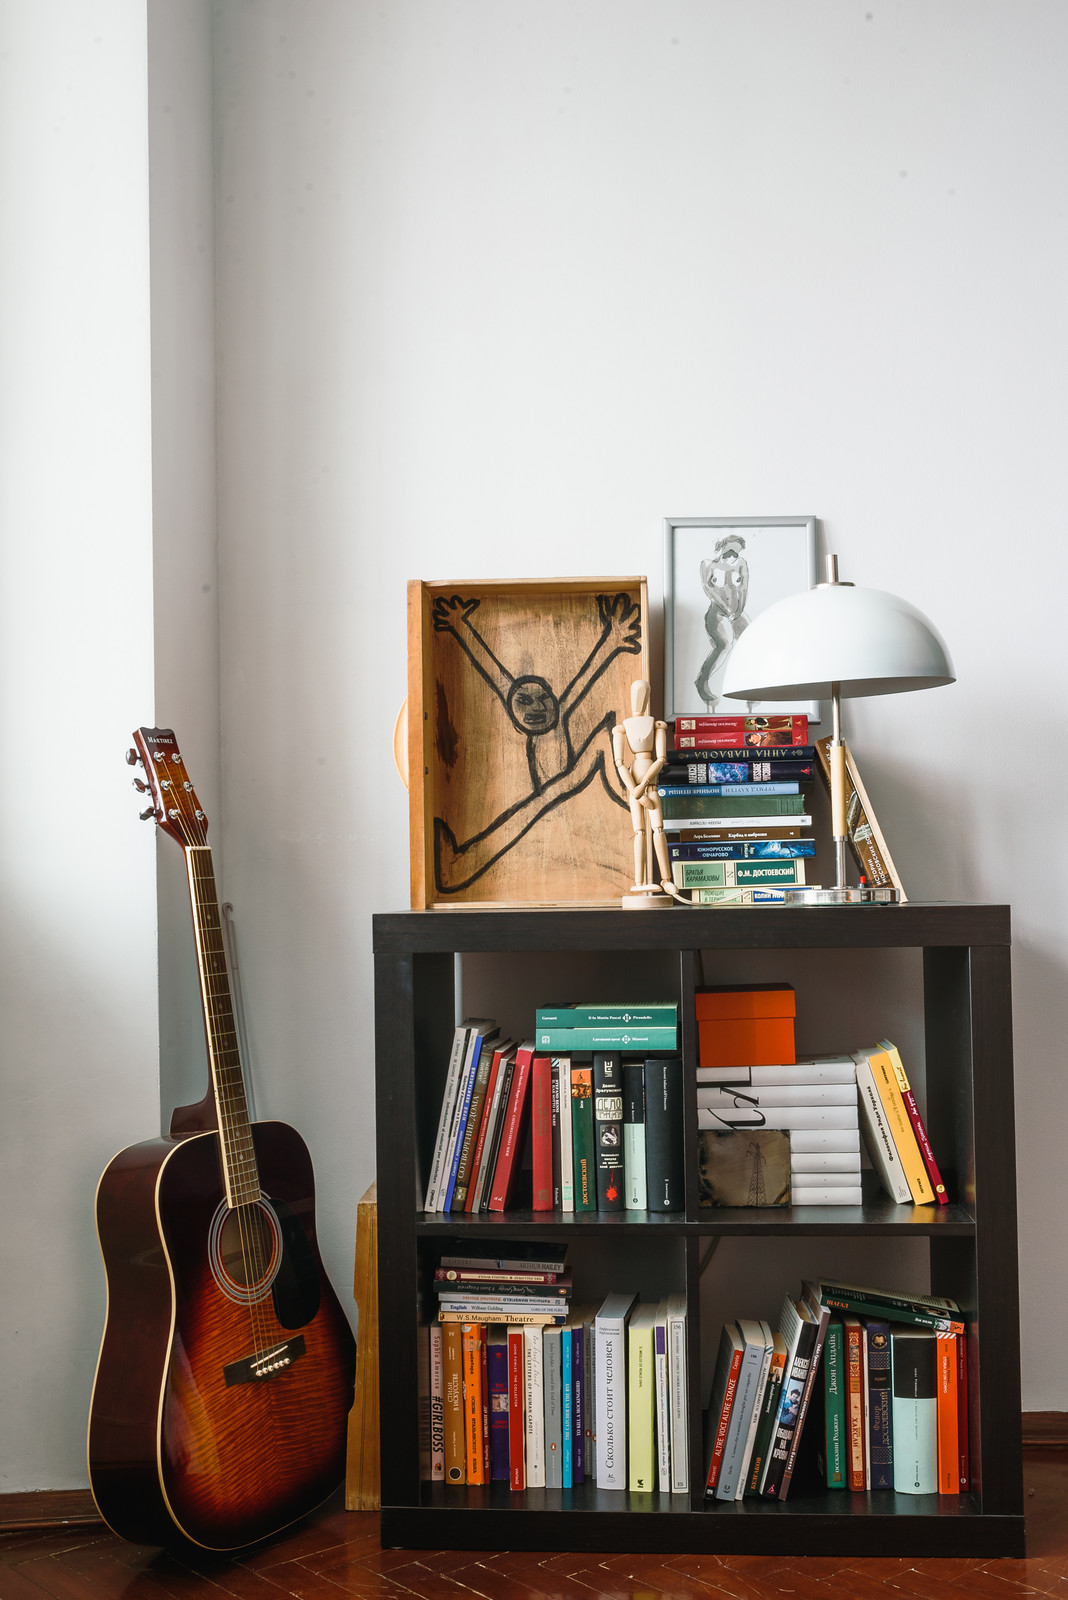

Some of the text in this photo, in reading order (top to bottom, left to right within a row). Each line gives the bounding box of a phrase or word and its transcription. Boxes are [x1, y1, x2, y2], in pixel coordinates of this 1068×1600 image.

[694, 750, 788, 758] АННА ПАВЛОВА
[752, 867, 794, 878] ДОСТОЕВСКИЙ
[868, 859, 880, 885] ИСТОРИИ
[869, 845, 887, 884] МОСКОВСКИХ
[464, 1067, 476, 1103] ЛЕВИТАНСКИЙ
[456, 1095, 481, 1179] СОТВОРЕНИЕ ДОМА
[866, 1085, 895, 1162] Философия Энди Уорхола
[826, 1299, 849, 1309] ШАГАЛ
[804, 1370, 816, 1401] Практический
[432, 1395, 443, 1453] #GIRLBOSS
[709, 1354, 740, 1483] Garzanti ALTRE VOCI ALTRE STANZE Capote
[799, 1401, 808, 1420] словарь
[605, 1422, 614, 1469] Сколько
[791, 1419, 803, 1451] классического
[851, 1418, 860, 1448] ХАКСЛИ
[749, 1456, 763, 1490] БУЛГАКОВ
[787, 1452, 796, 1470] балета
